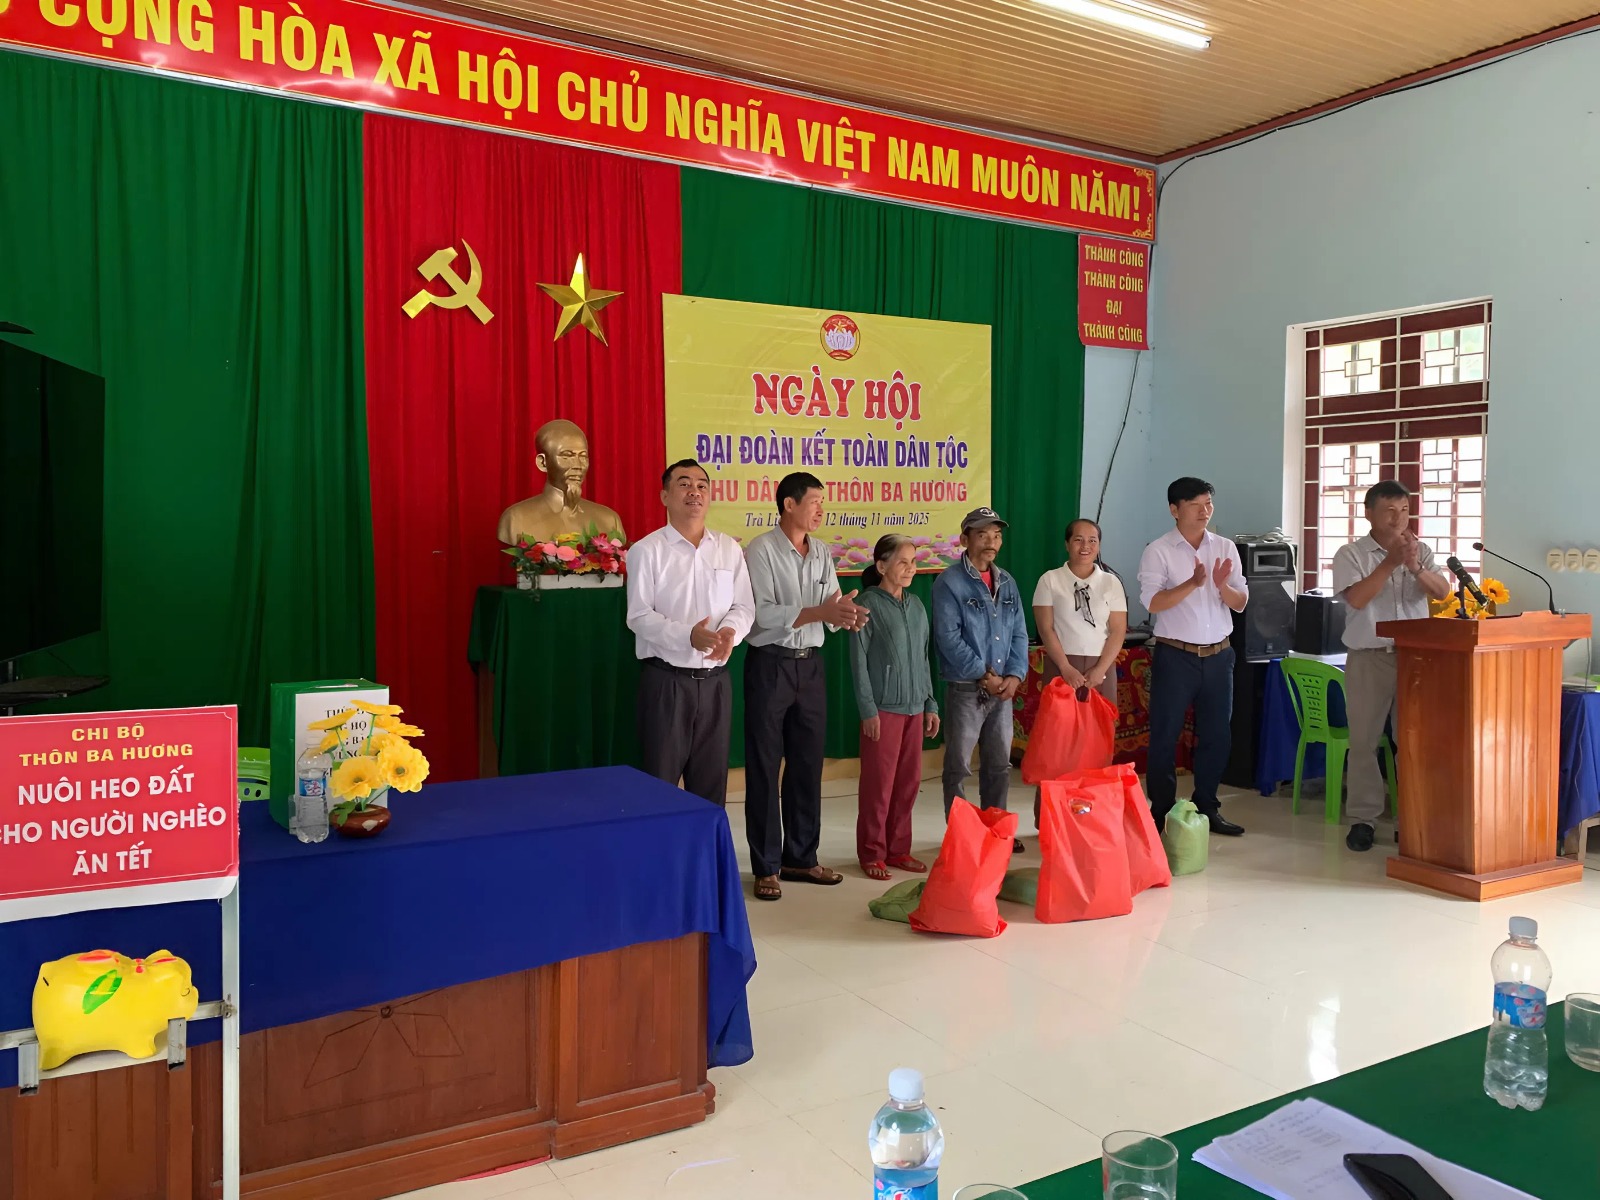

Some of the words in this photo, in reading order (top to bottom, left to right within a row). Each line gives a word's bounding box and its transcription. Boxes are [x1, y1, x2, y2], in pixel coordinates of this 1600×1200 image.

[239, 2, 355, 79] HÒA
[373, 30, 440, 95] XÃ
[458, 47, 539, 121] HỘI
[557, 69, 648, 132] CHỦ
[665, 91, 786, 158] NGHĨA
[797, 116, 876, 179] VIỆT
[888, 136, 959, 189] NAM
[972, 154, 1059, 208] MUÔN
[1070, 169, 1140, 222] NĂM!
[1084, 243, 1116, 263] THÀNH
[1084, 269, 1116, 289] THÀNH
[1106, 299, 1122, 318] ĐẠI
[1083, 320, 1115, 340] THÀNH
[752, 365, 855, 417] NGÀY
[864, 370, 921, 431] HỘI
[696, 434, 732, 470] ĐẠI
[739, 429, 794, 465] ĐOÀN
[801, 428, 836, 466] KẾT
[841, 432, 888, 467] TOÀN
[895, 434, 930, 468] DÂN
[935, 435, 968, 474] TỘC
[711, 480, 739, 502] HU
[826, 476, 874, 502] THÔN
[881, 482, 903, 502] BA
[910, 479, 967, 502] HƯƠNG
[746, 512, 763, 527] Trà
[826, 512, 837, 526] 12
[839, 512, 868, 529] tháng
[871, 512, 881, 526] 11
[884, 513, 905, 526] năm
[908, 512, 930, 525] 2025
[72, 727, 109, 742] CHI
[117, 722, 145, 741] BỘ
[19, 749, 78, 767] THÔN
[86, 748, 114, 763] BA
[122, 743, 193, 760] HƯƠNG
[18, 776, 82, 806] NUÔI
[91, 776, 141, 800] HEO
[148, 764, 195, 796] ĐẤT
[0, 822, 42, 845] HO
[51, 809, 134, 841] NGƯỜI
[142, 802, 227, 832] NGHÈO
[72, 850, 108, 876] ĂN
[116, 840, 152, 871] TẾT
